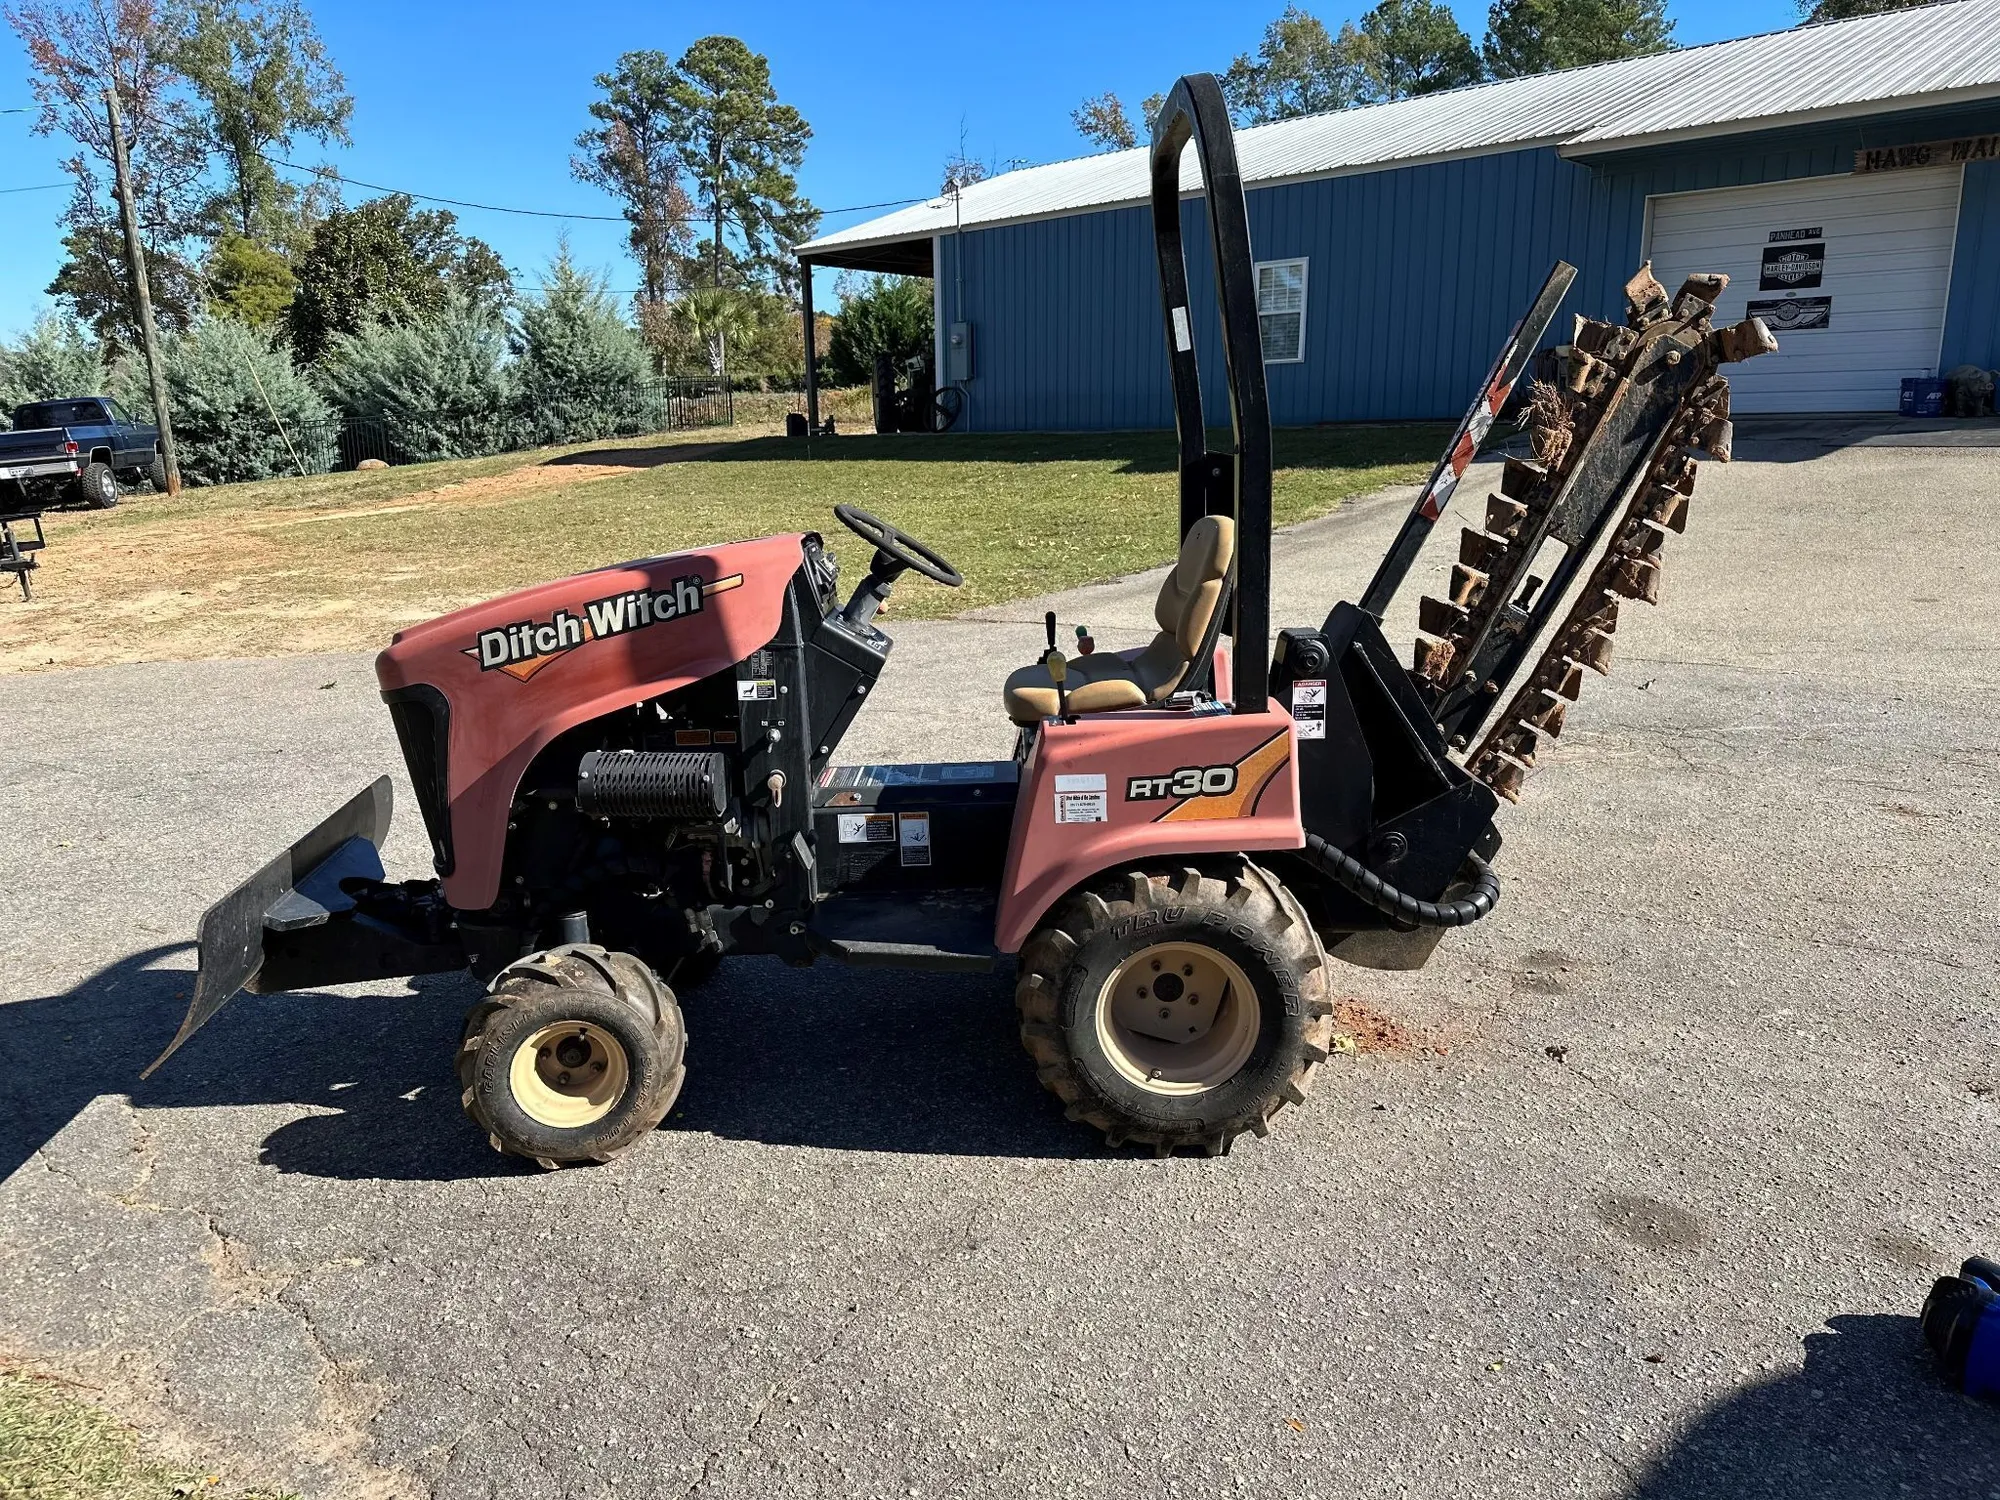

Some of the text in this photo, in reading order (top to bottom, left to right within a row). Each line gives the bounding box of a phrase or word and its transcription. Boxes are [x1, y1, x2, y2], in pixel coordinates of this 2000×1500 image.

[1769, 230, 1806, 241] PANHEAD
[1780, 253, 1806, 262] MOTOR
[481, 614, 581, 668] Ditch
[1129, 767, 1235, 798] RT30
[1110, 906, 1300, 1017] TRU POWER
